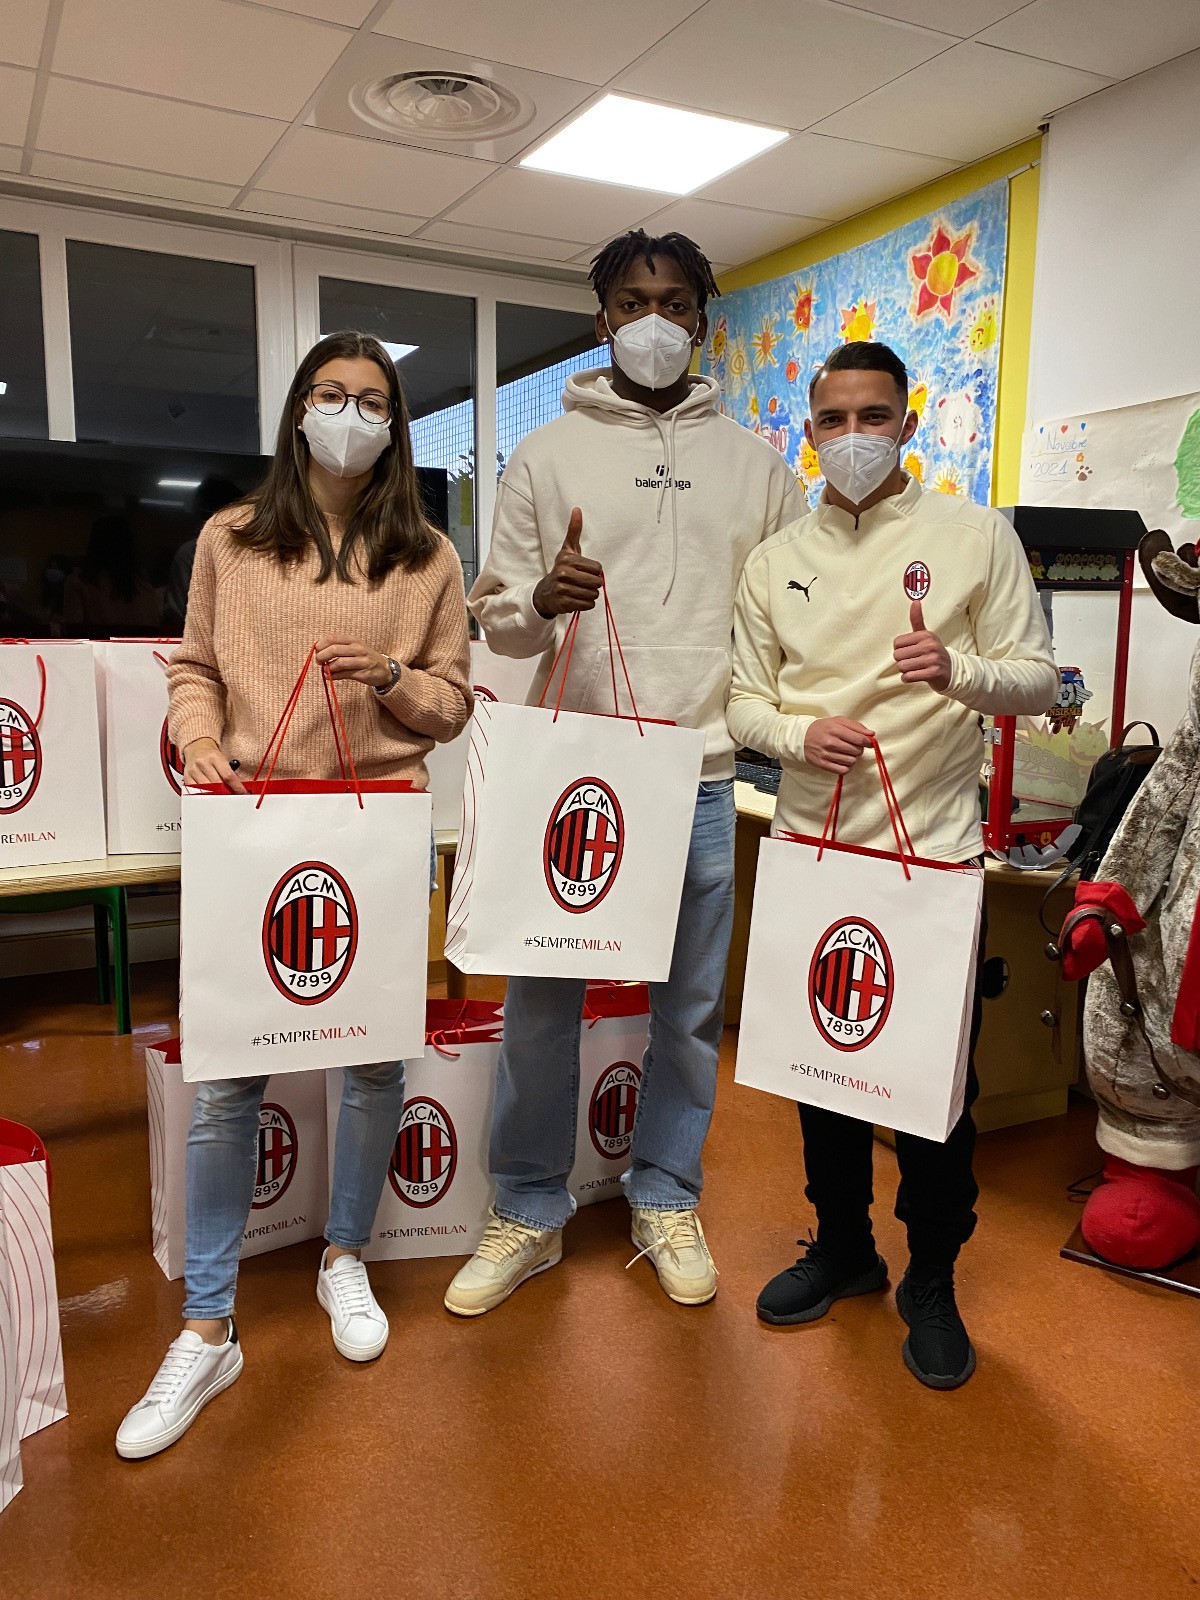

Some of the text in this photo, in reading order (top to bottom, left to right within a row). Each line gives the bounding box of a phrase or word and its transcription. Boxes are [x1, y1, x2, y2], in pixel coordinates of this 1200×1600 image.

[1034, 460, 1068, 477] 2021
[566, 788, 610, 815] ACM
[1, 831, 56, 844] REMILAN
[285, 873, 338, 902] ACM
[560, 880, 597, 897] 1899
[523, 935, 622, 952] #SEMPREMILAN
[831, 928, 878, 957] ACM
[288, 971, 332, 988] 1899
[826, 1016, 865, 1037] 1899
[250, 1025, 368, 1046] #SEMPREMILAN
[603, 1069, 637, 1090] ACM
[789, 1062, 892, 1099] #SEMPREMILAN
[259, 1112, 283, 1127] CM
[401, 1106, 441, 1128] ACM
[603, 1135, 631, 1149] 1899
[254, 1181, 280, 1198] 899
[405, 1182, 439, 1195] 1899
[579, 1174, 621, 1191] #SEMPRE
[243, 1215, 307, 1240] MPREMILAN
[378, 1224, 467, 1239] #SEMPREMILAN
